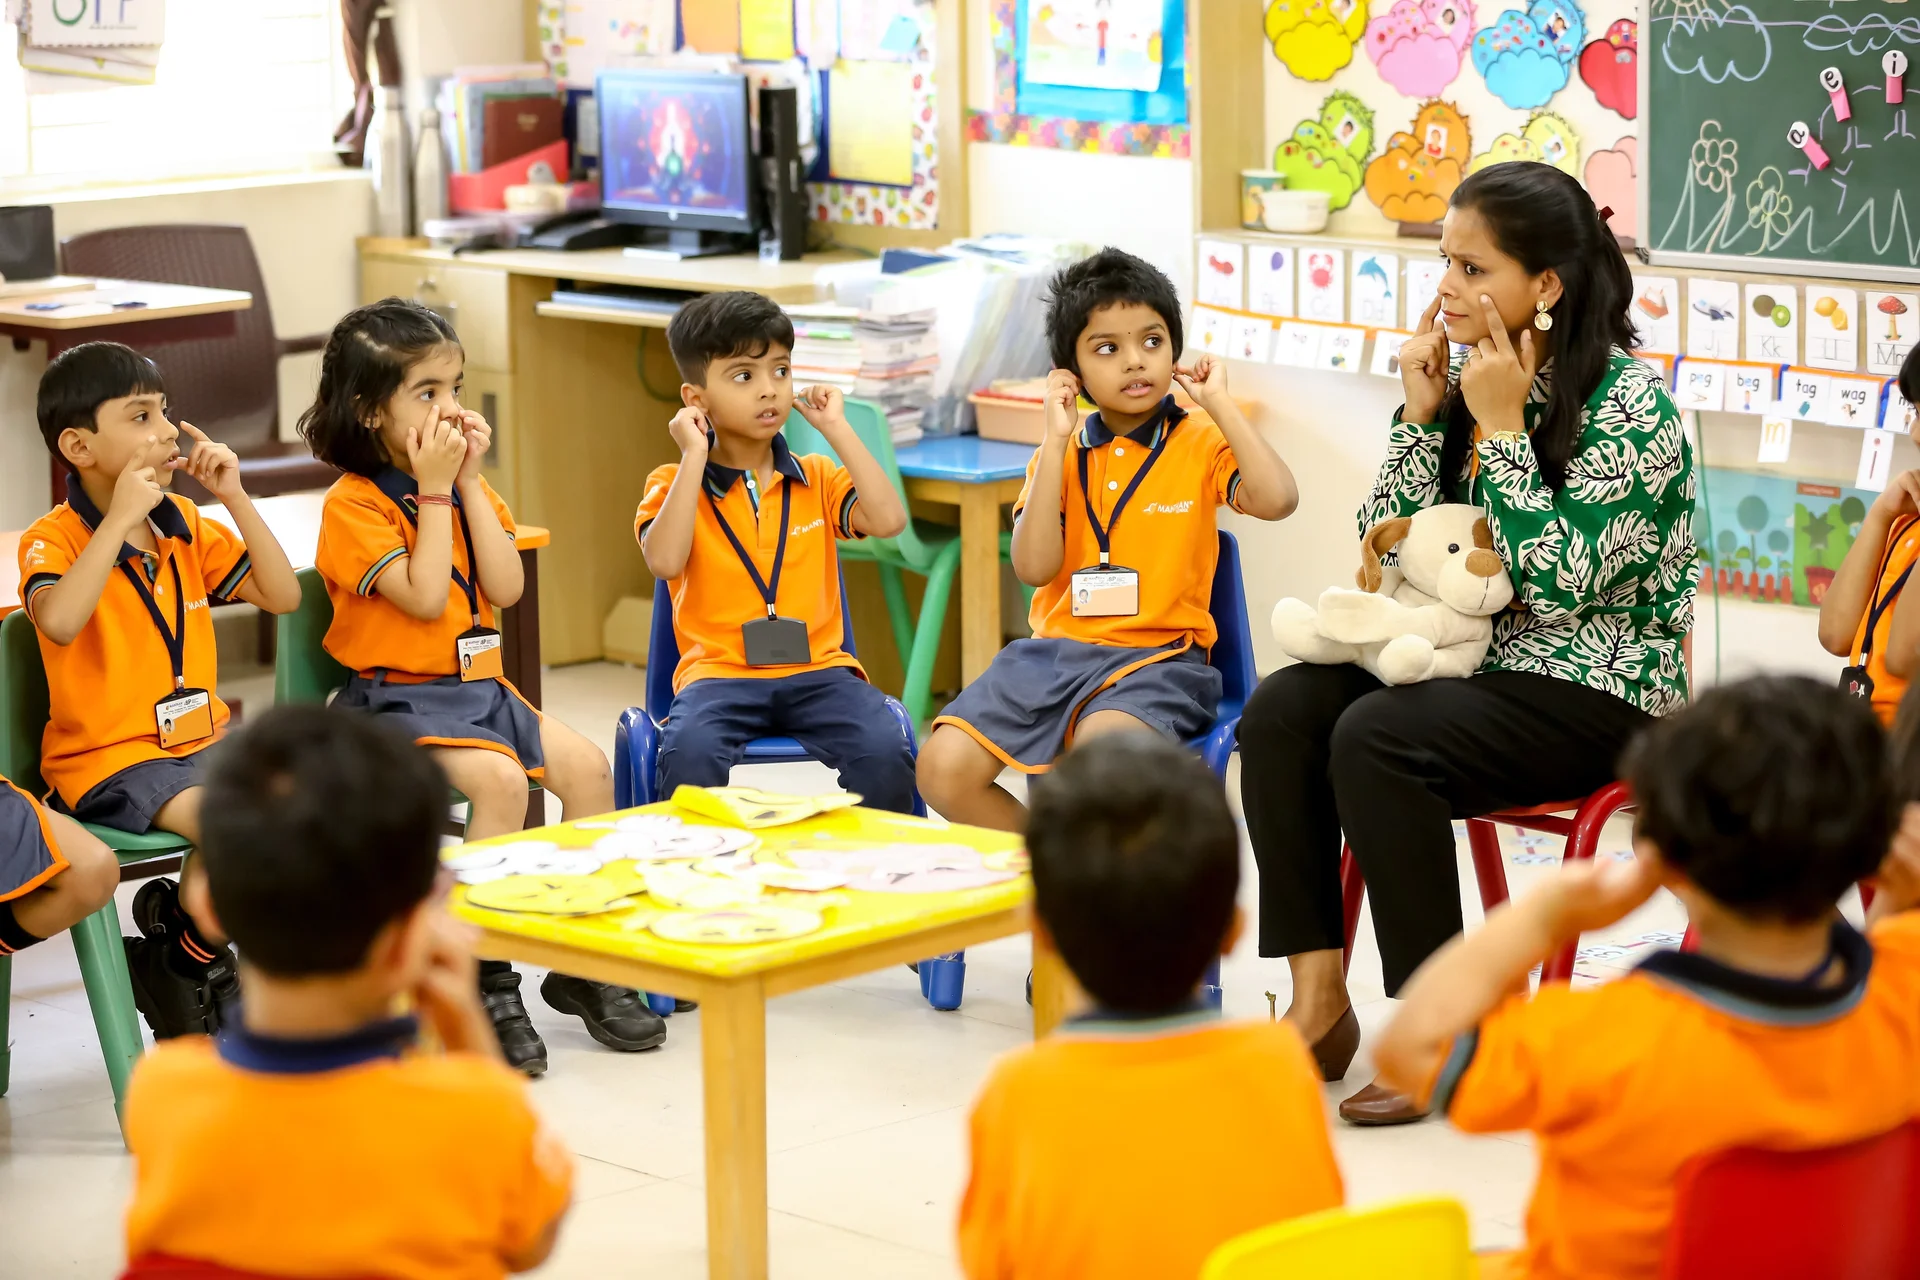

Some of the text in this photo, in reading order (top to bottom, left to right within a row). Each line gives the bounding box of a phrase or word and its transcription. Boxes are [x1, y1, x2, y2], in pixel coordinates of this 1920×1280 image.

[1892, 52, 1898, 75] i
[1824, 70, 1839, 89] e
[1790, 129, 1805, 146] a
[1761, 335, 1781, 358] Kk
[1689, 373, 1712, 388] peg
[1736, 373, 1760, 392] beg
[1796, 379, 1817, 399] tag
[1841, 389, 1867, 405] wag
[1765, 422, 1786, 444] m
